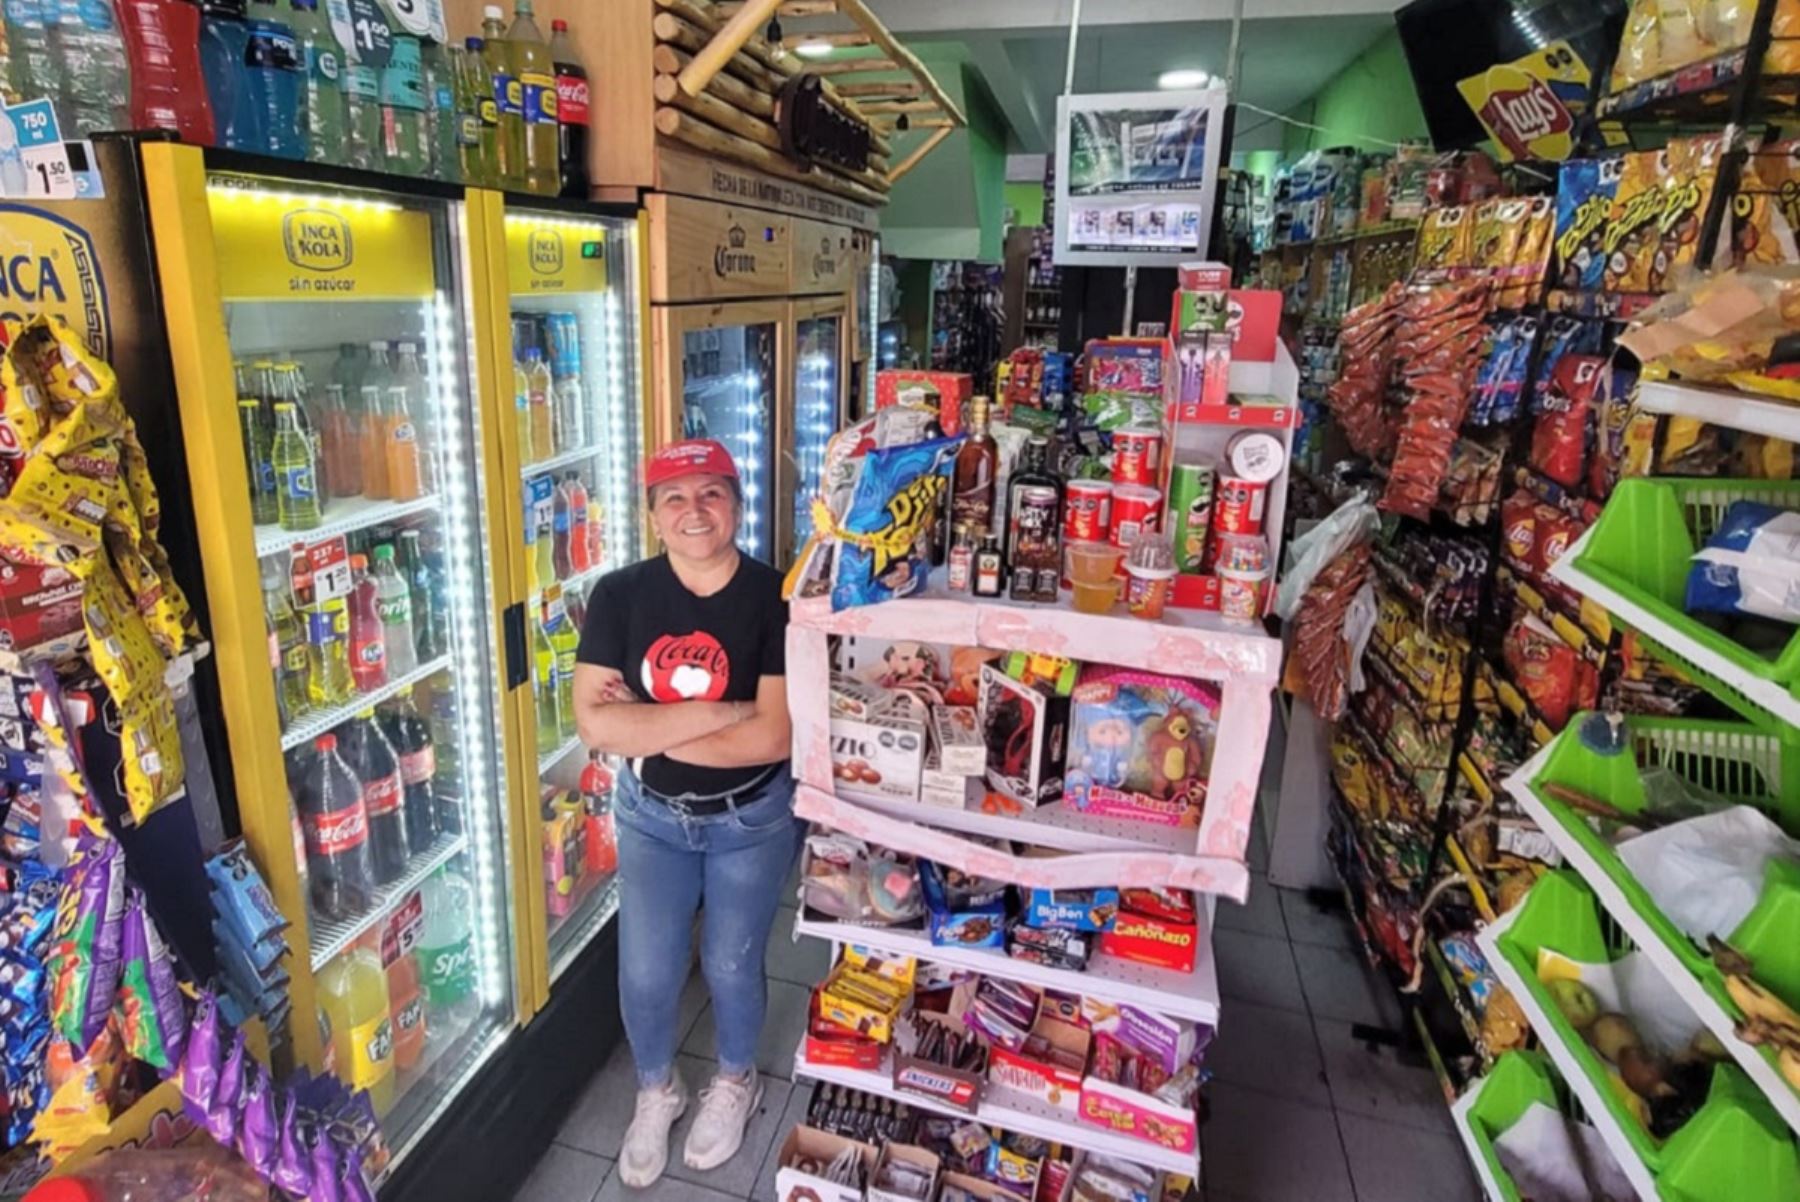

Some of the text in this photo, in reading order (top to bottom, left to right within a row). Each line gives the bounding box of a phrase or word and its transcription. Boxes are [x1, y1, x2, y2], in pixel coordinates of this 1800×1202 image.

[21, 111, 48, 130] 750
[300, 223, 338, 241] INCA
[299, 240, 342, 258] KOLA
[714, 243, 757, 280] Corona
[289, 277, 312, 291] sin
[1113, 920, 1191, 946] Cañonazo
[905, 1070, 953, 1092] SNICKERS
